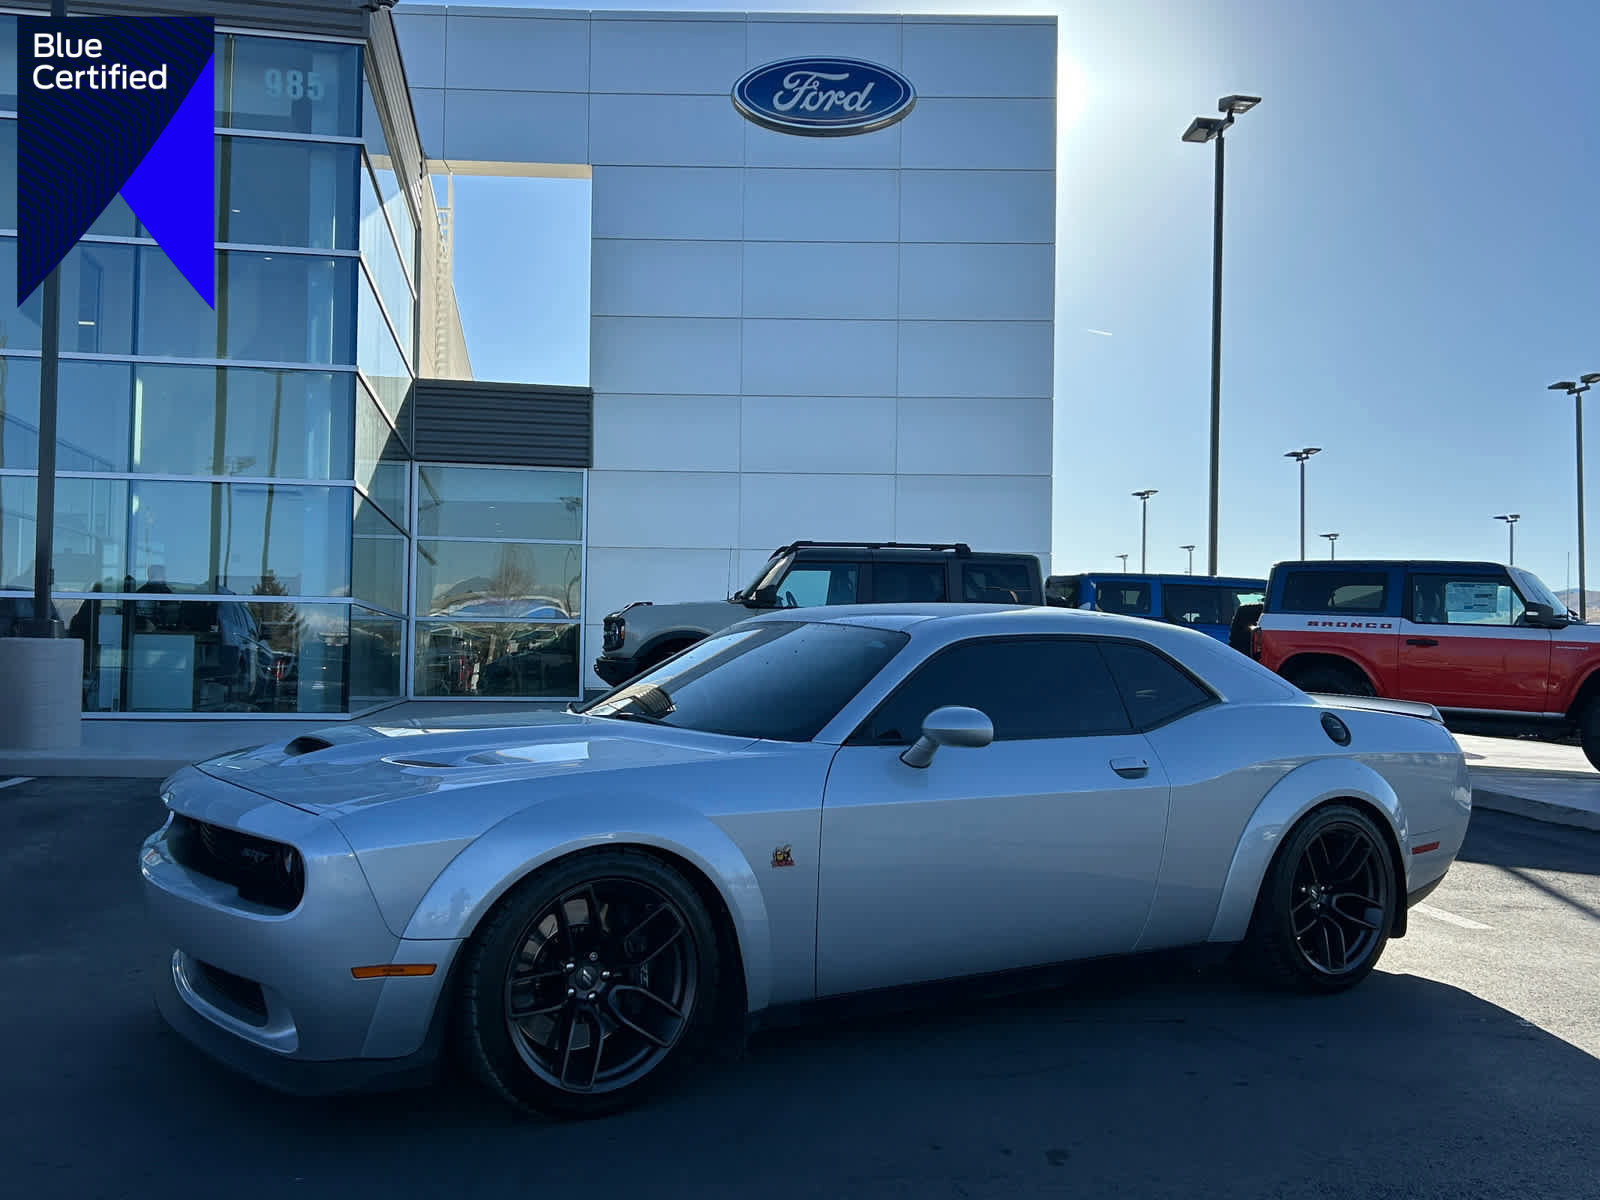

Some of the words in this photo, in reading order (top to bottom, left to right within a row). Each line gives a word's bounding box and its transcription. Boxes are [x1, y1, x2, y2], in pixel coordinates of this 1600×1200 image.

[264, 69, 325, 100] 985
[772, 70, 876, 112] Ford
[1307, 620, 1393, 629] BRONCO
